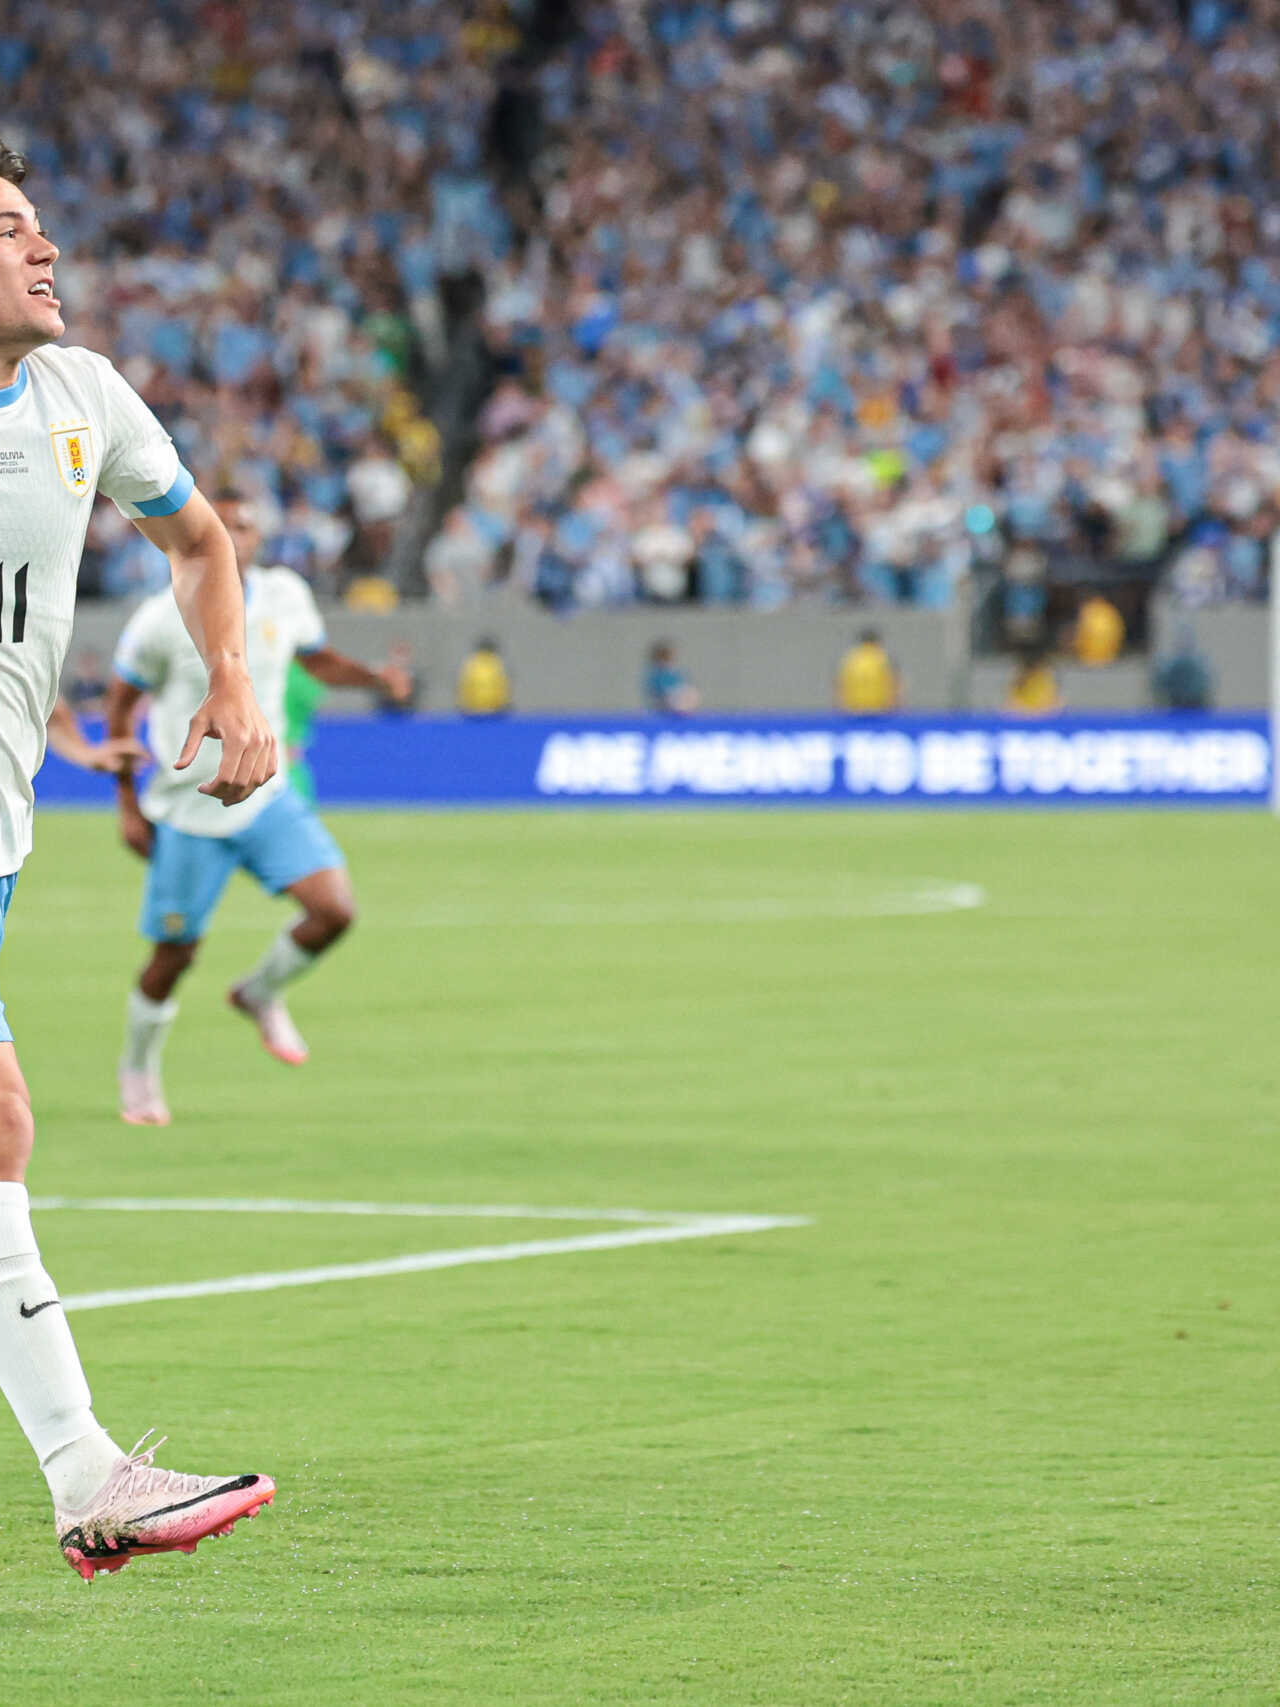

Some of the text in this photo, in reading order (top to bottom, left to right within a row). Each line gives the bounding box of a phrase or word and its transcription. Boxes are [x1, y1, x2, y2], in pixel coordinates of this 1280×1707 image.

[70, 441, 81, 464] AUF
[537, 731, 1270, 794] ARE MEANT TO BE TOGETHER
